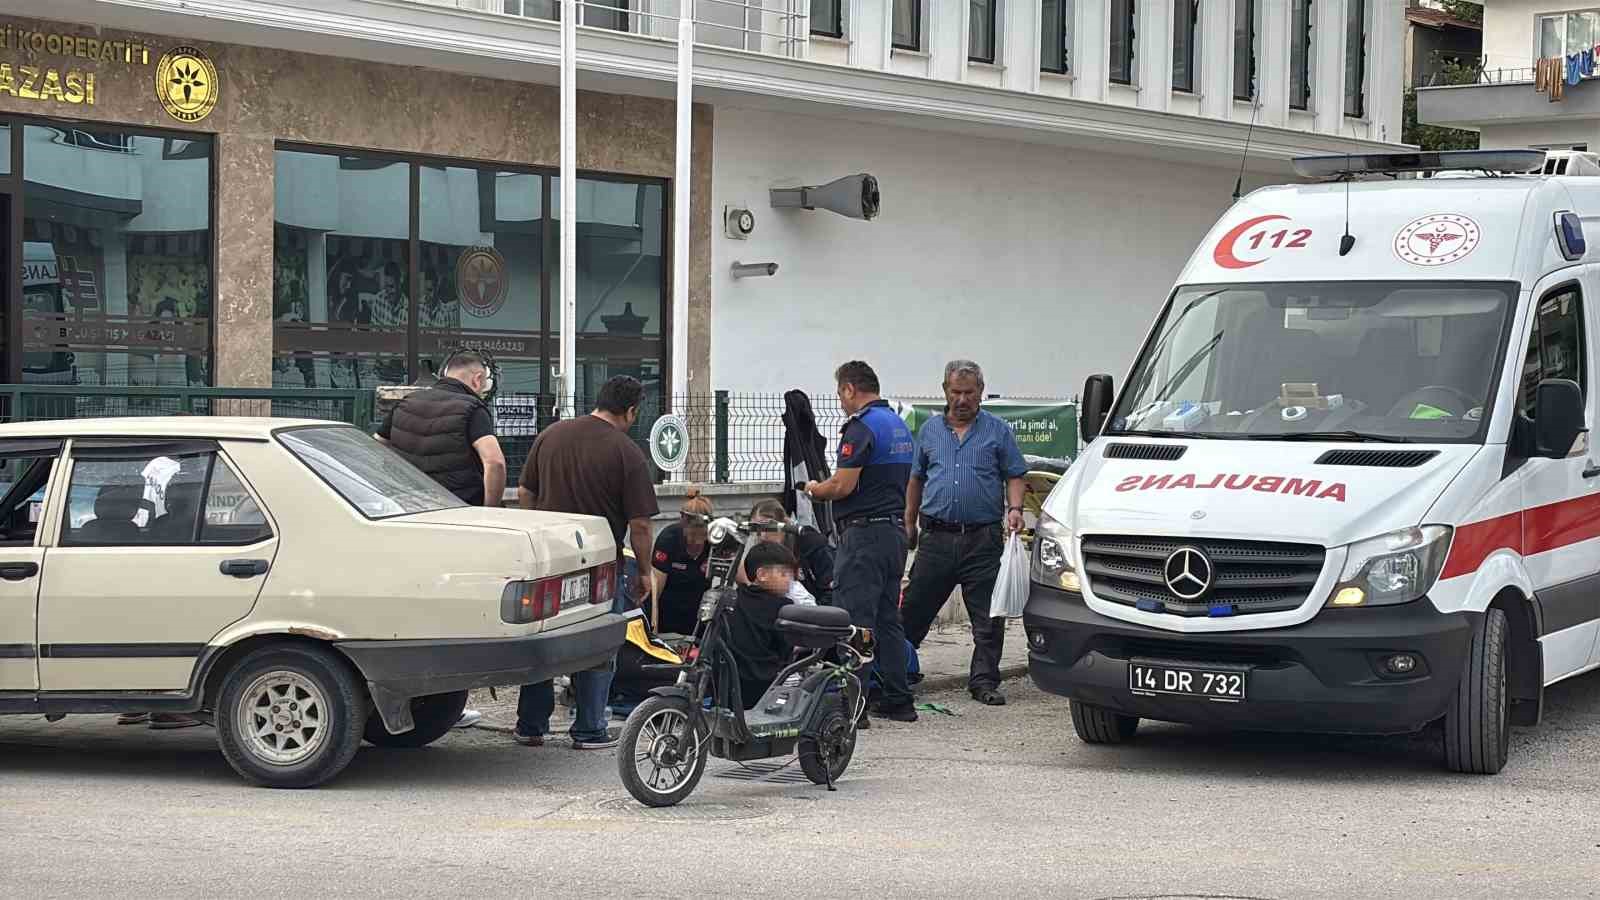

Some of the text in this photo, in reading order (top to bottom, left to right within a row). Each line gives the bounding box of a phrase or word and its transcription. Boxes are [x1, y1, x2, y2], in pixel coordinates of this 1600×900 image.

[19, 27, 150, 65] KOOPERATİFİ
[1249, 229, 1313, 250] 112
[1135, 667, 1241, 695] 14 DR 732
